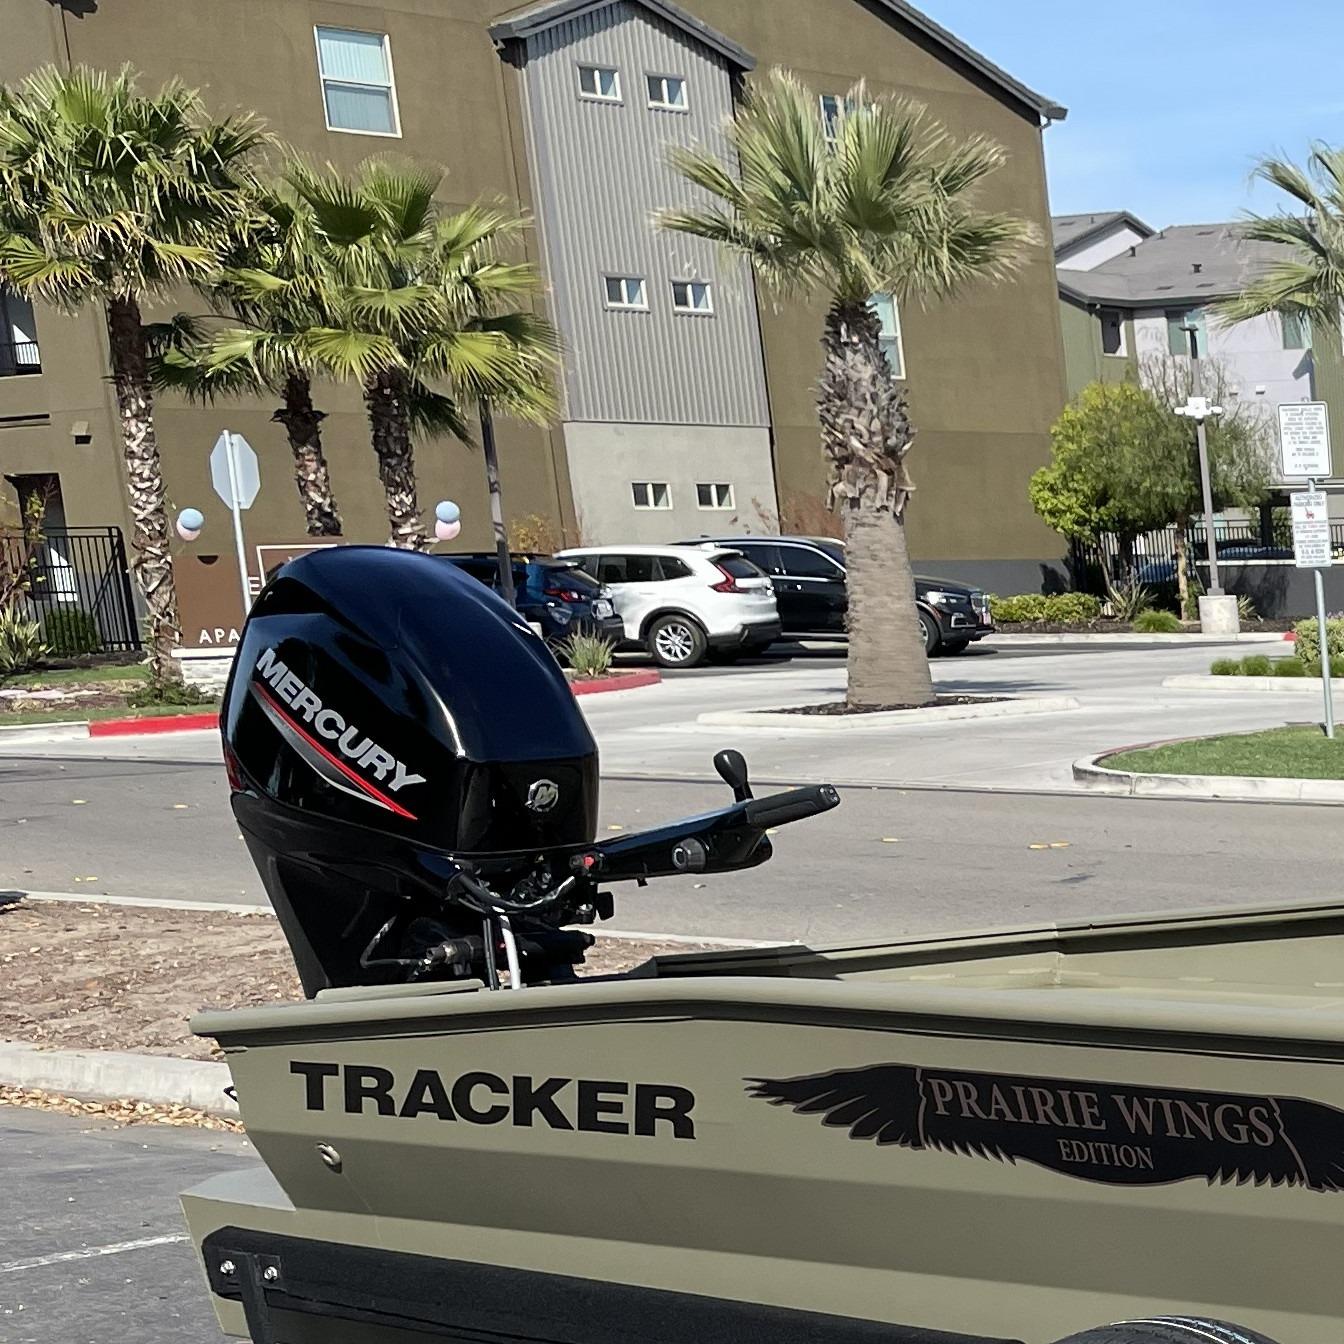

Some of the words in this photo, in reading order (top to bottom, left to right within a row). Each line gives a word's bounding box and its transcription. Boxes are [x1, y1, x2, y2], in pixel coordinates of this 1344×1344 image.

[256, 648, 427, 792] MERCURY
[290, 1061, 697, 1141] TRACKER
[928, 1078, 1108, 1131] PRAIRIE
[1111, 1094, 1275, 1147] WINGS
[1057, 1139, 1154, 1170] EDITION
